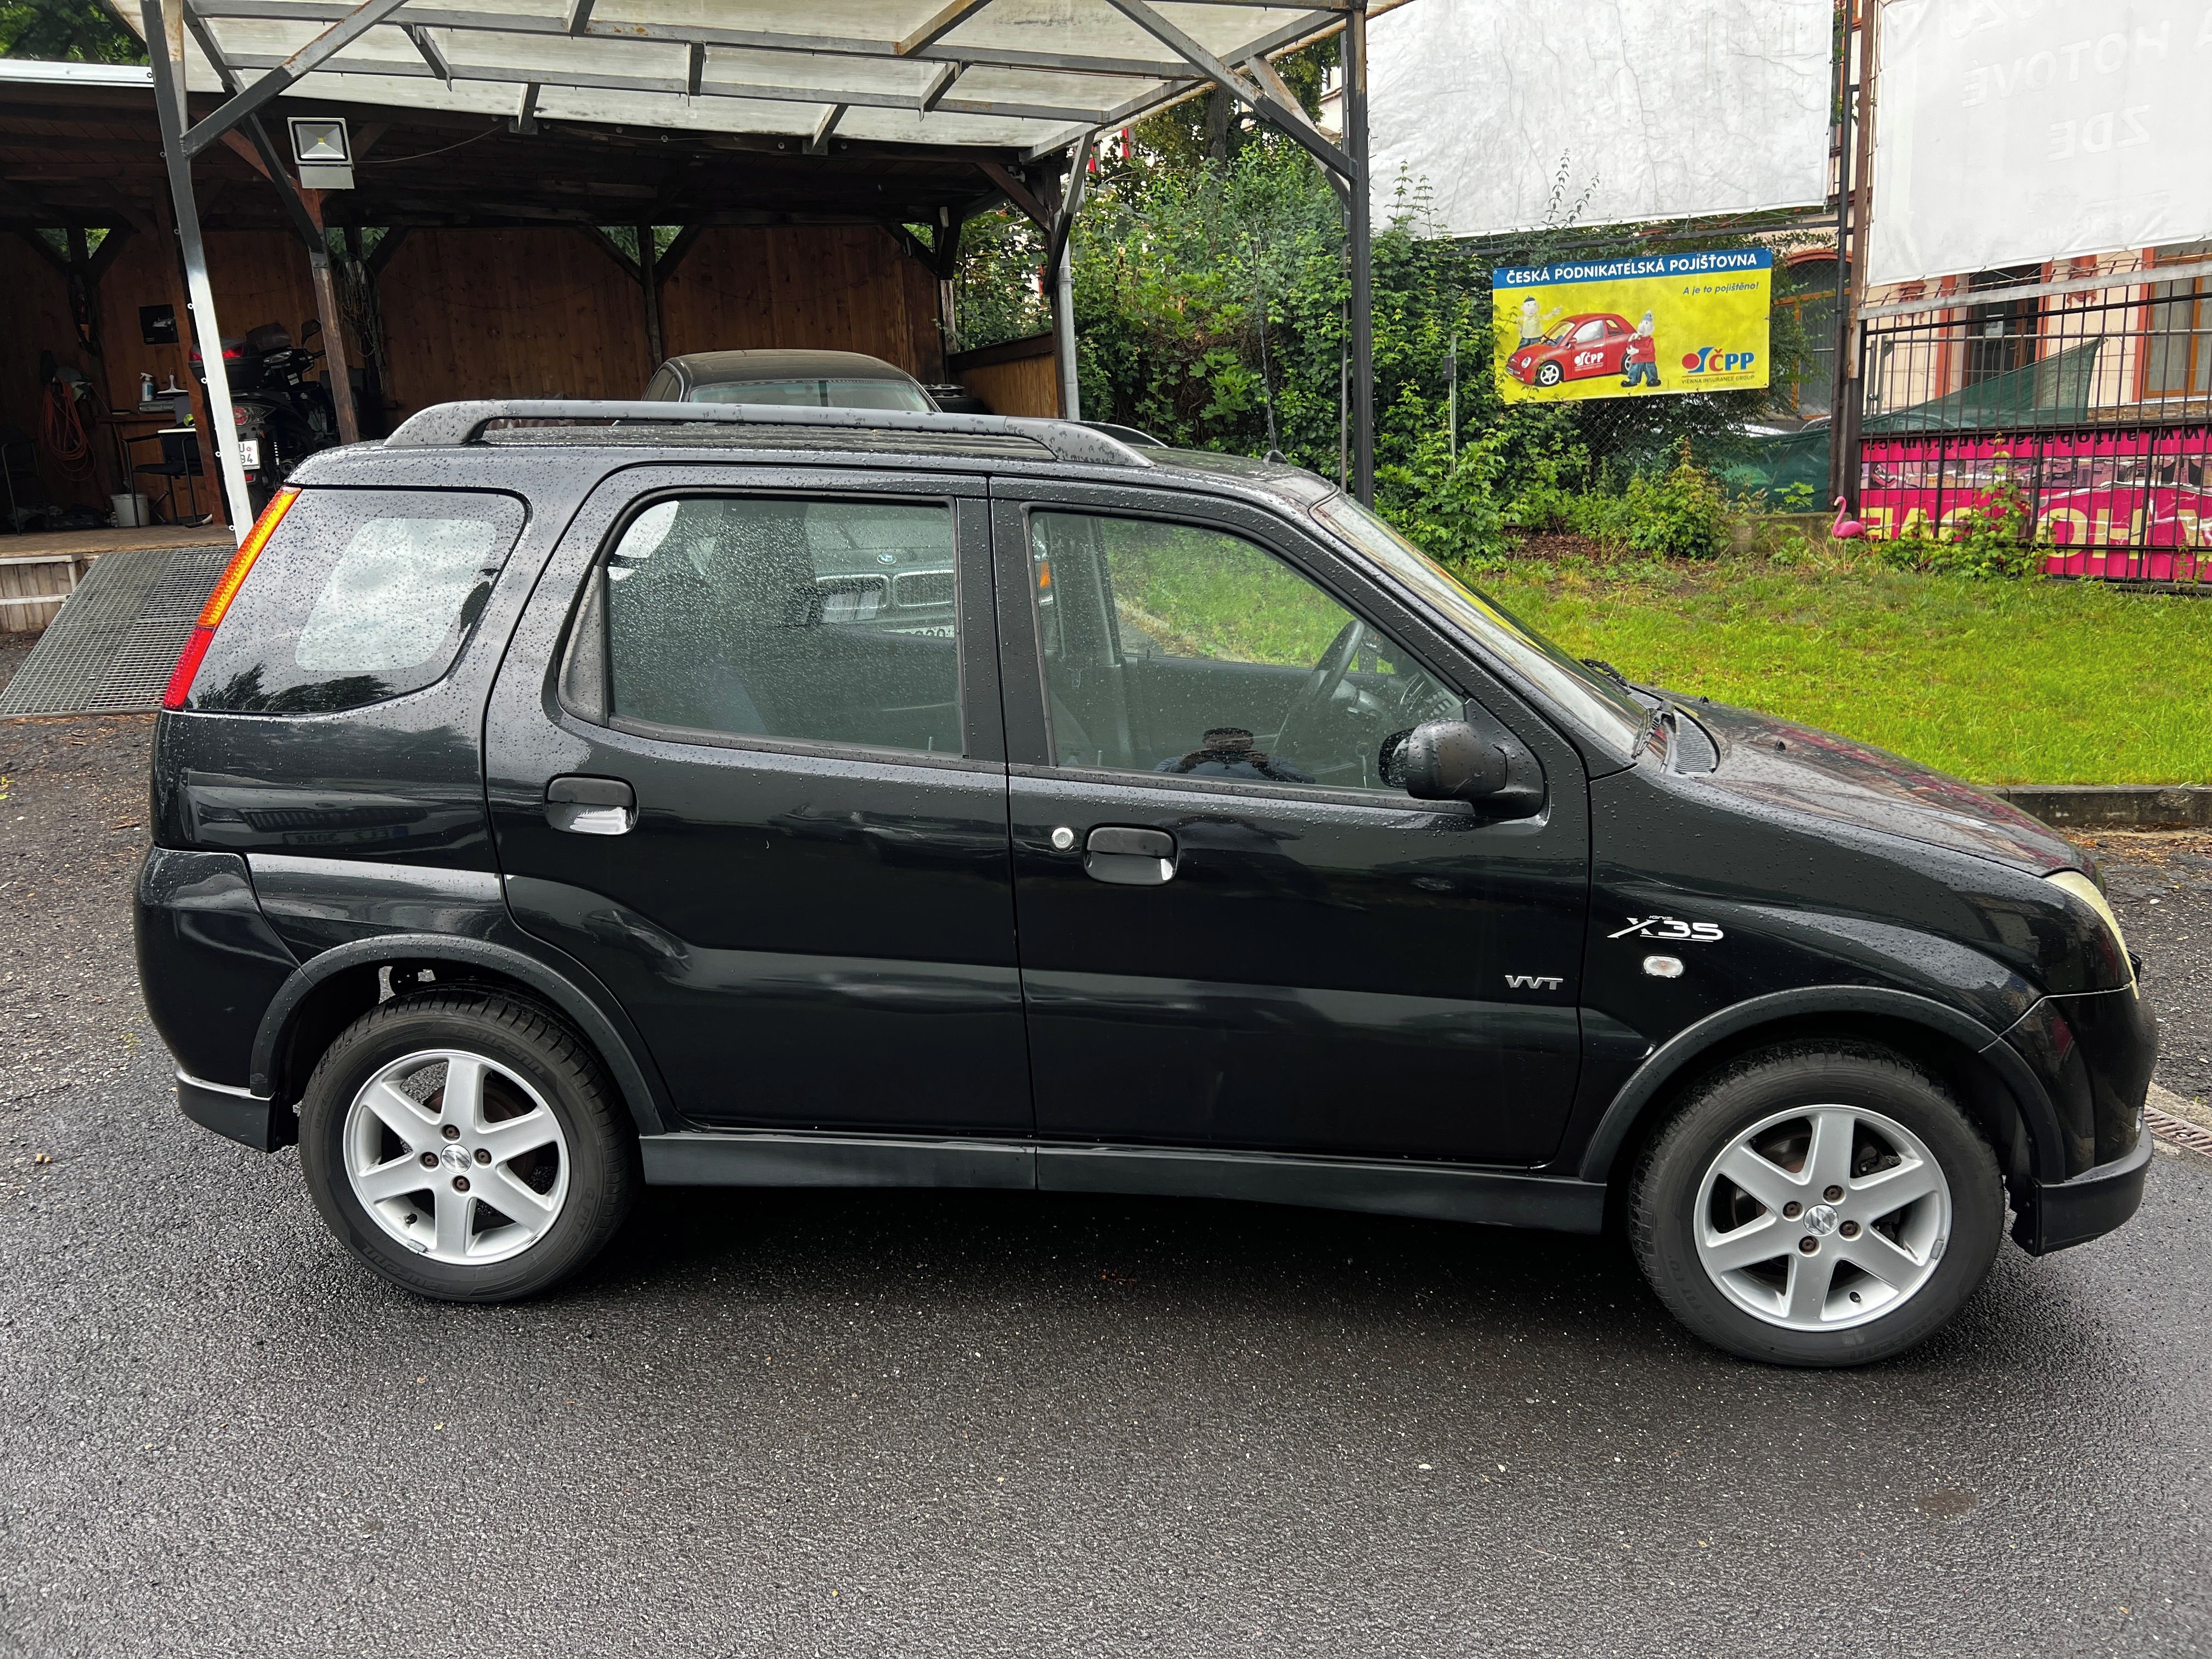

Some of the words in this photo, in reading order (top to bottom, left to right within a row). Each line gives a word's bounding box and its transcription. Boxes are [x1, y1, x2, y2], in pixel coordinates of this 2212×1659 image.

[1506, 267, 1550, 284] ČESKÁ
[1555, 258, 1665, 280] PODNIKATELSKÁ
[1670, 253, 1757, 272] POJIŠŤOVNA
[1692, 286, 1701, 296] je
[1714, 281, 1759, 295] pojištěno!
[1584, 352, 1604, 365] ČPP
[1708, 348, 1754, 372] ČPP
[1607, 917, 1724, 941] X35
[1505, 974, 1564, 990] VVT
